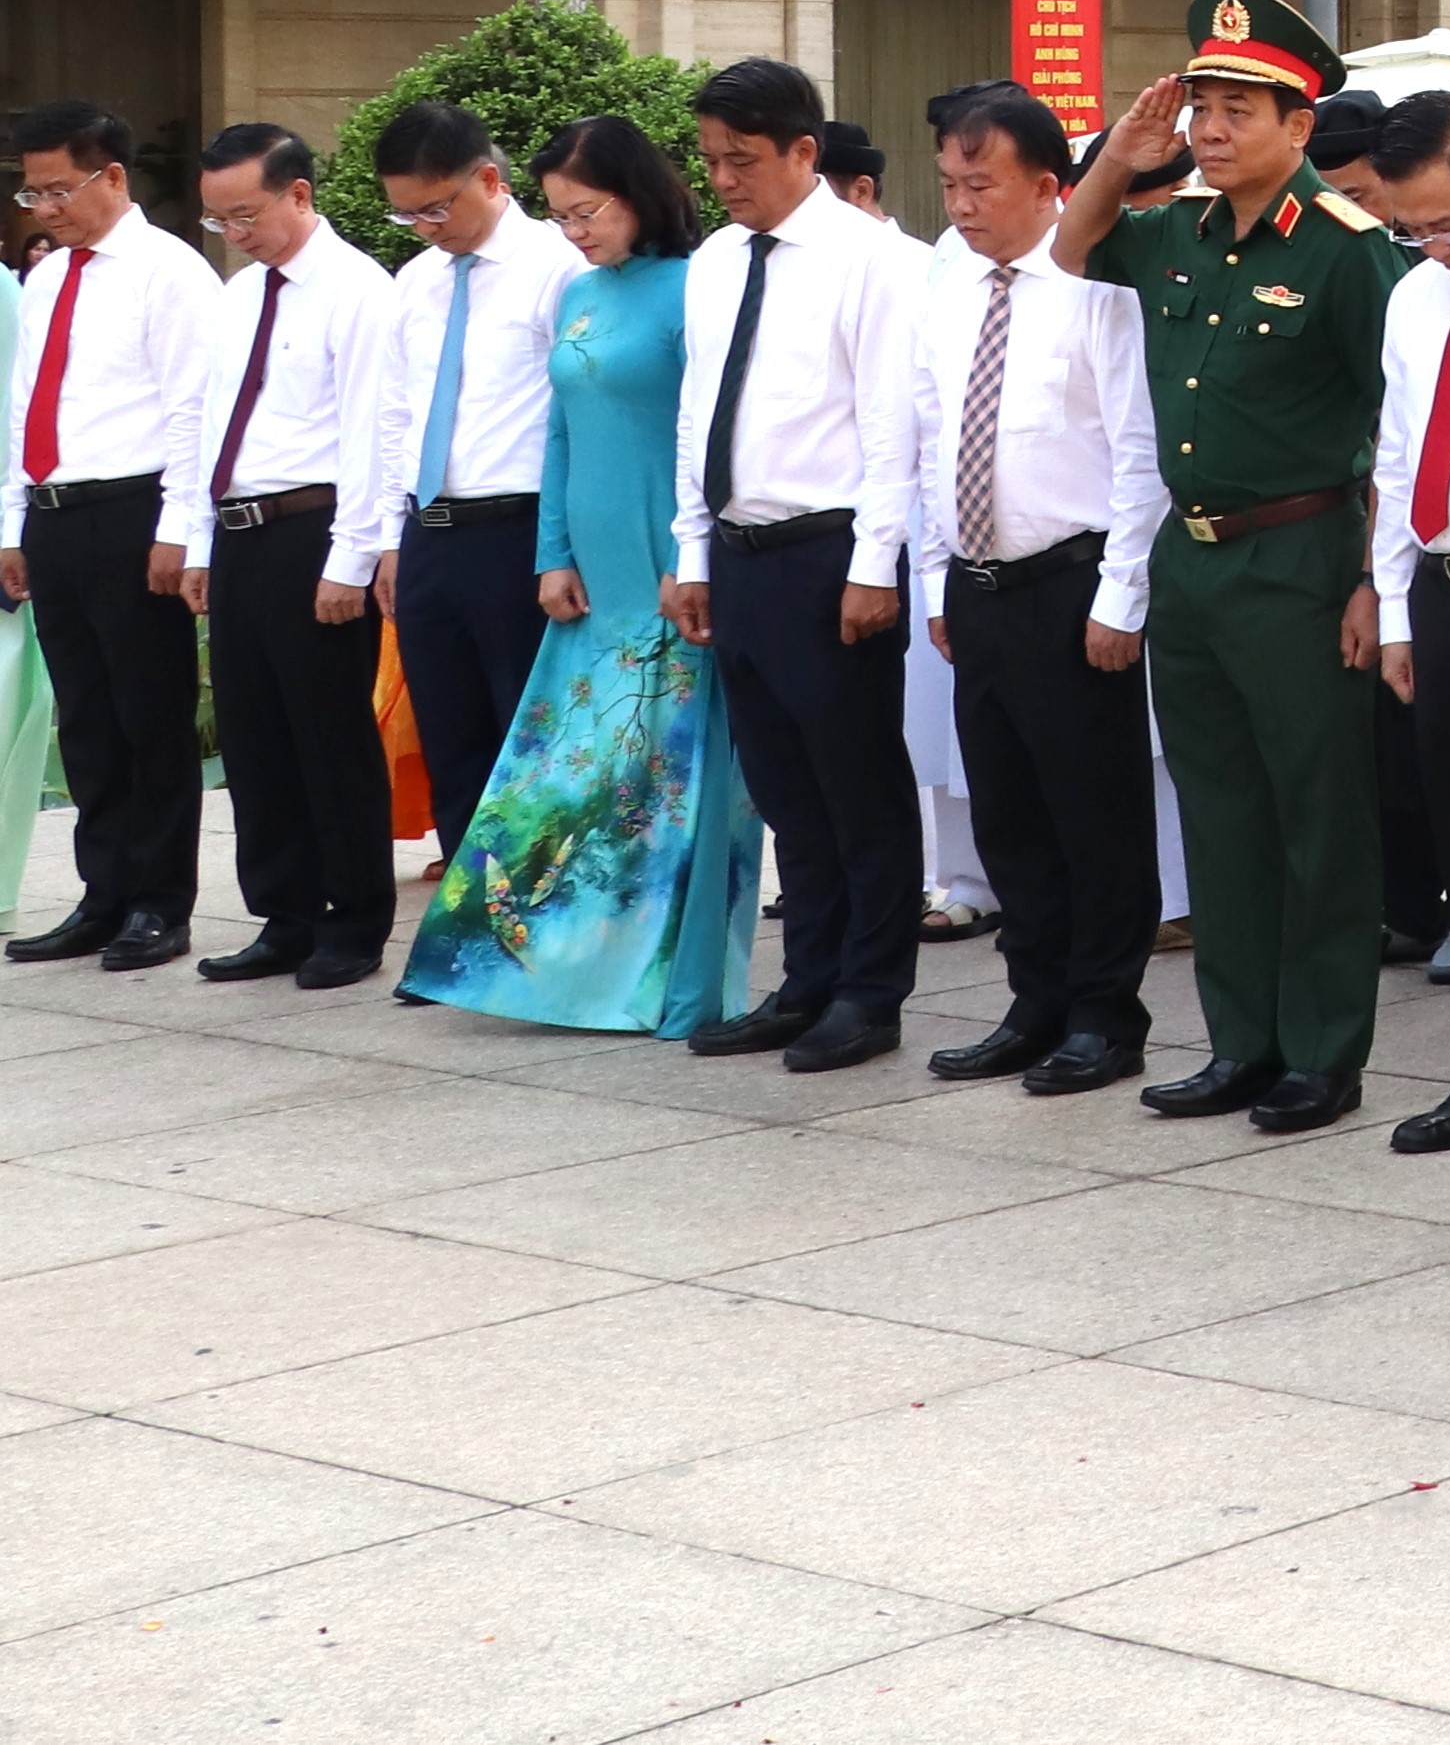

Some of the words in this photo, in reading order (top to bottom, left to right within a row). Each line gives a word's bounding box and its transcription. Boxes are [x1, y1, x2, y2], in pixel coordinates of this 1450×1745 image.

[1056, 0, 1076, 15] TỊCH
[1060, 24, 1084, 37] MINH
[1034, 48, 1054, 61] ANH
[1055, 46, 1079, 61] HÙNG
[1052, 69, 1082, 85] PHÓNG
[1055, 93, 1074, 111] VIỆT
